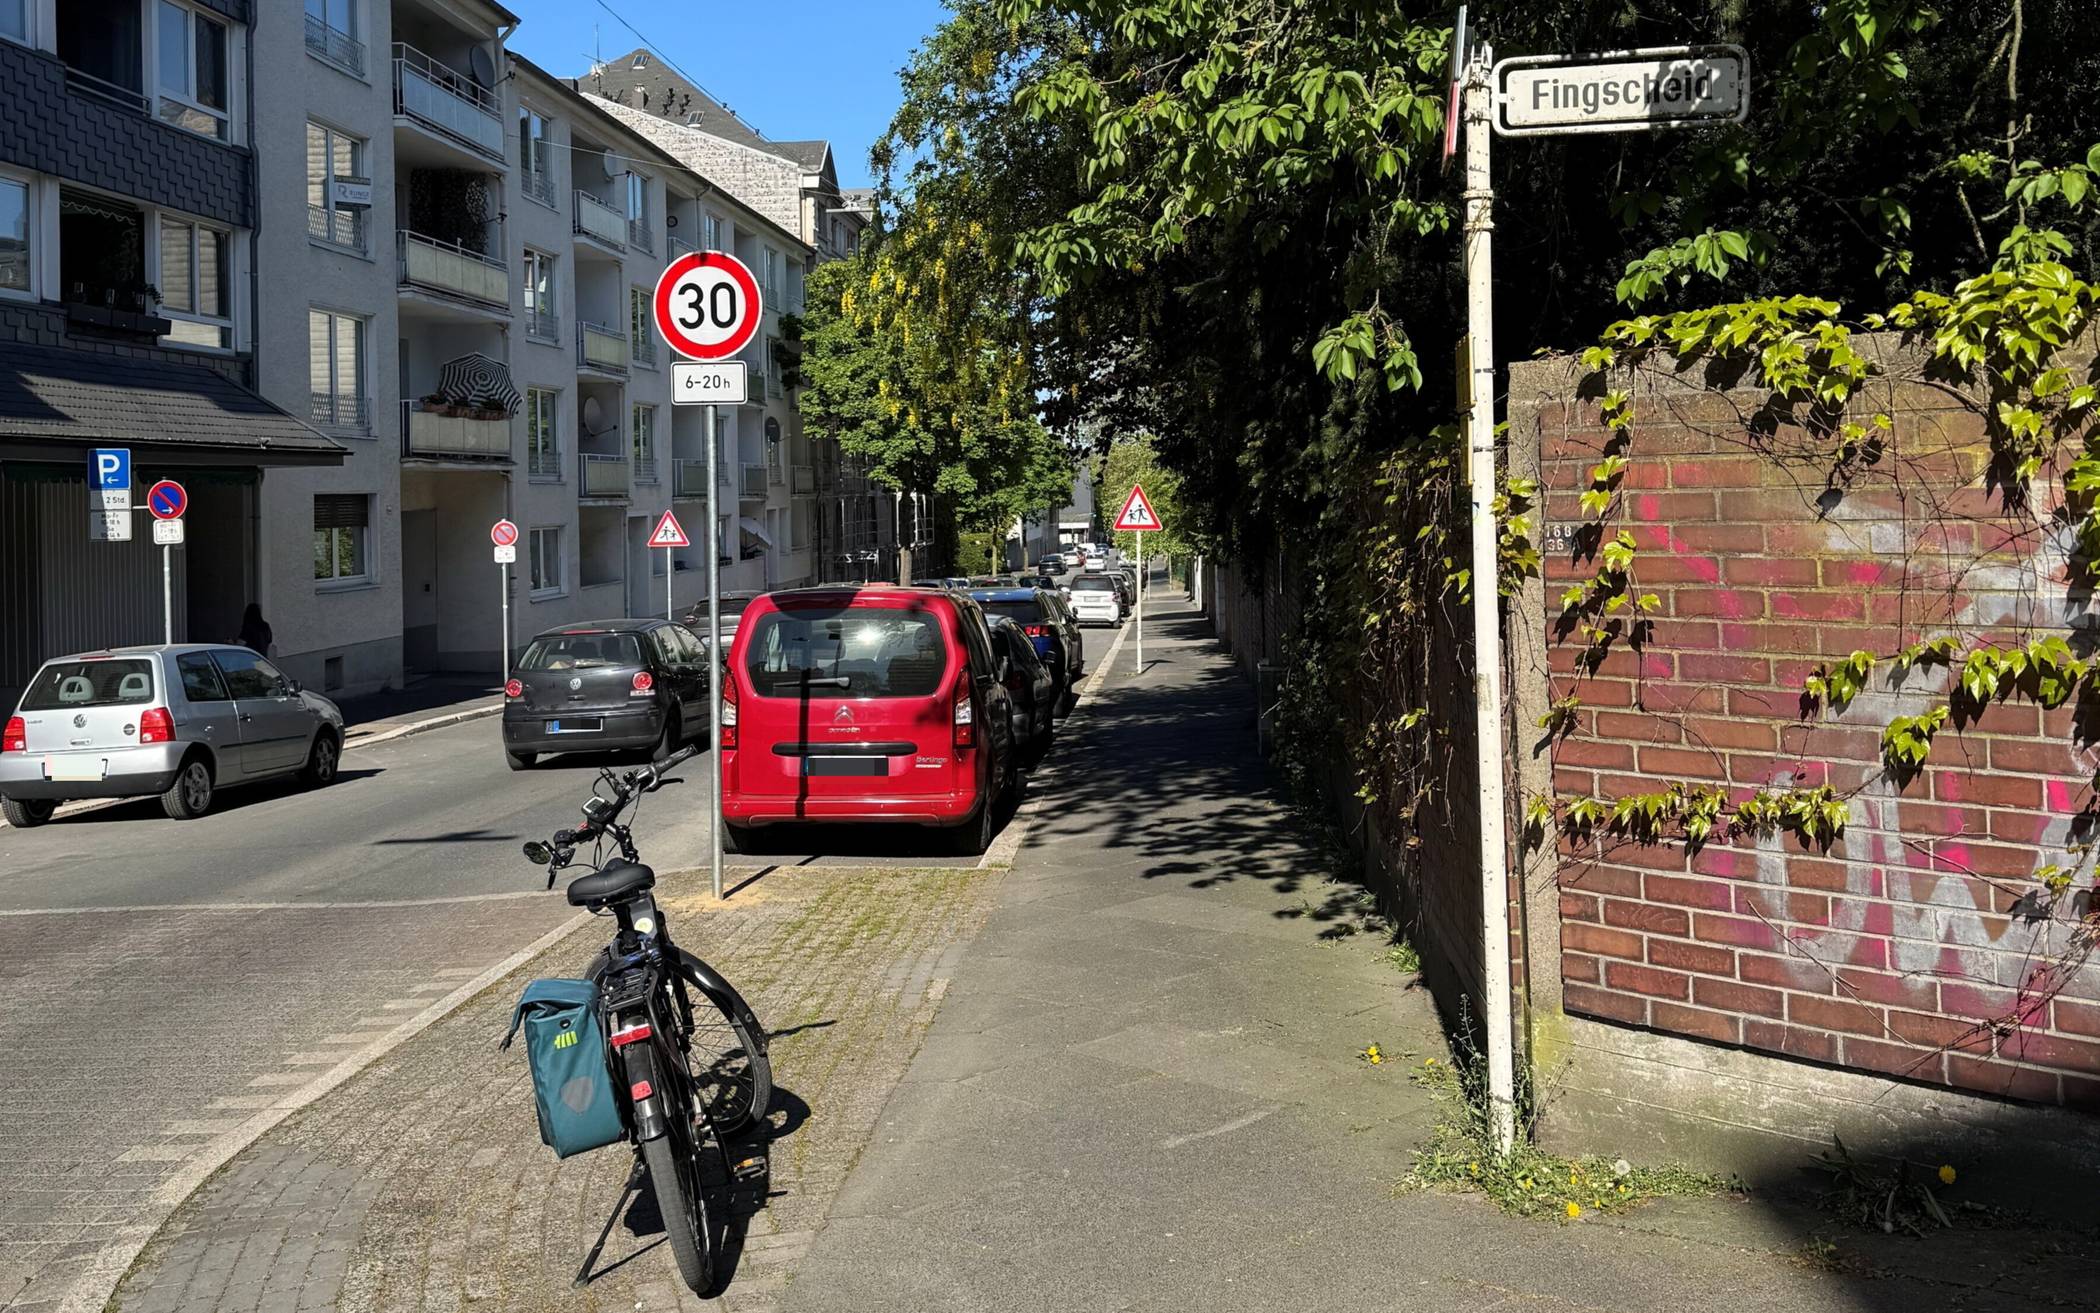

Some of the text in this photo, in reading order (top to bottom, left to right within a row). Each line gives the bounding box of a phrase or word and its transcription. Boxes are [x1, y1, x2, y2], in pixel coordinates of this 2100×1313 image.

[1532, 68, 1713, 114] Fingscheid
[678, 282, 737, 330] 30
[97, 454, 120, 484] P
